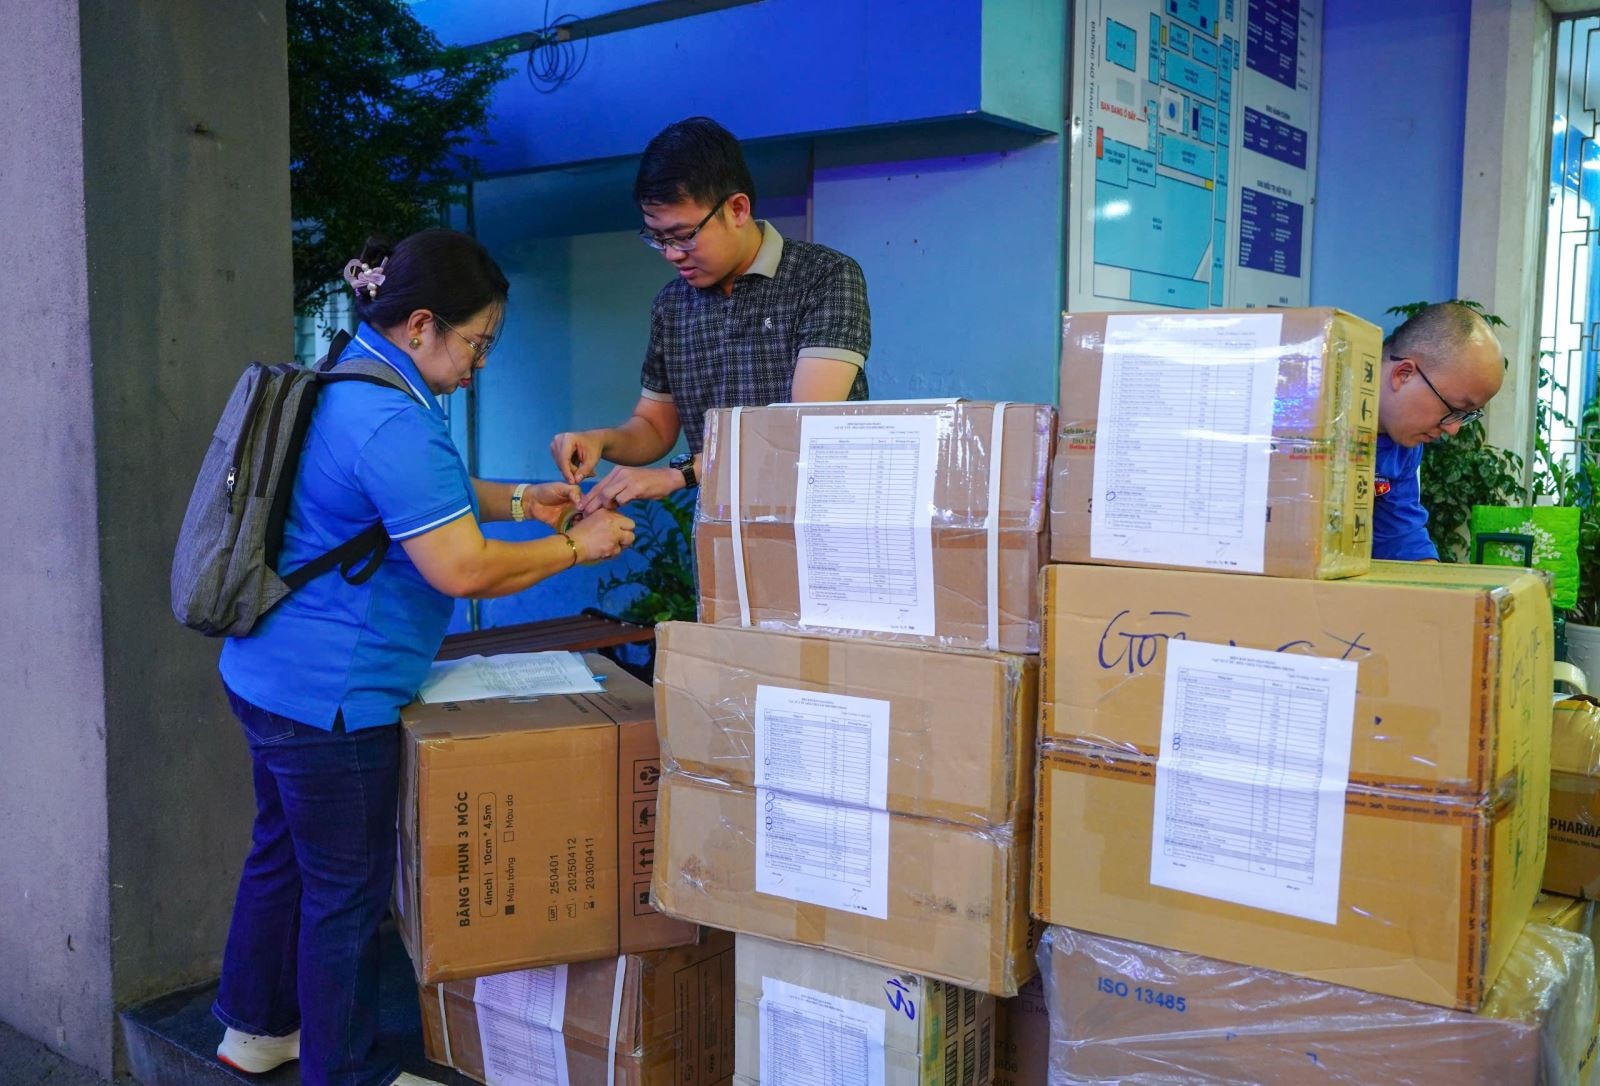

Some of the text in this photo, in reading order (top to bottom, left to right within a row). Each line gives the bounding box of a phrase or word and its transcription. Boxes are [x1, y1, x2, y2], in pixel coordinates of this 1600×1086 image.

[455, 791, 469, 825] MÓC
[484, 805, 493, 829] 4,5m
[505, 794, 513, 806] da
[458, 843, 469, 883] THUN
[483, 839, 493, 866] 10cm
[567, 837, 577, 893] 20250412
[585, 837, 595, 890] 20300411
[483, 879, 493, 906] 4inch
[550, 854, 559, 895] 250401
[457, 887, 470, 927] BĂNG
[1097, 976, 1187, 1013] ISO 13485
